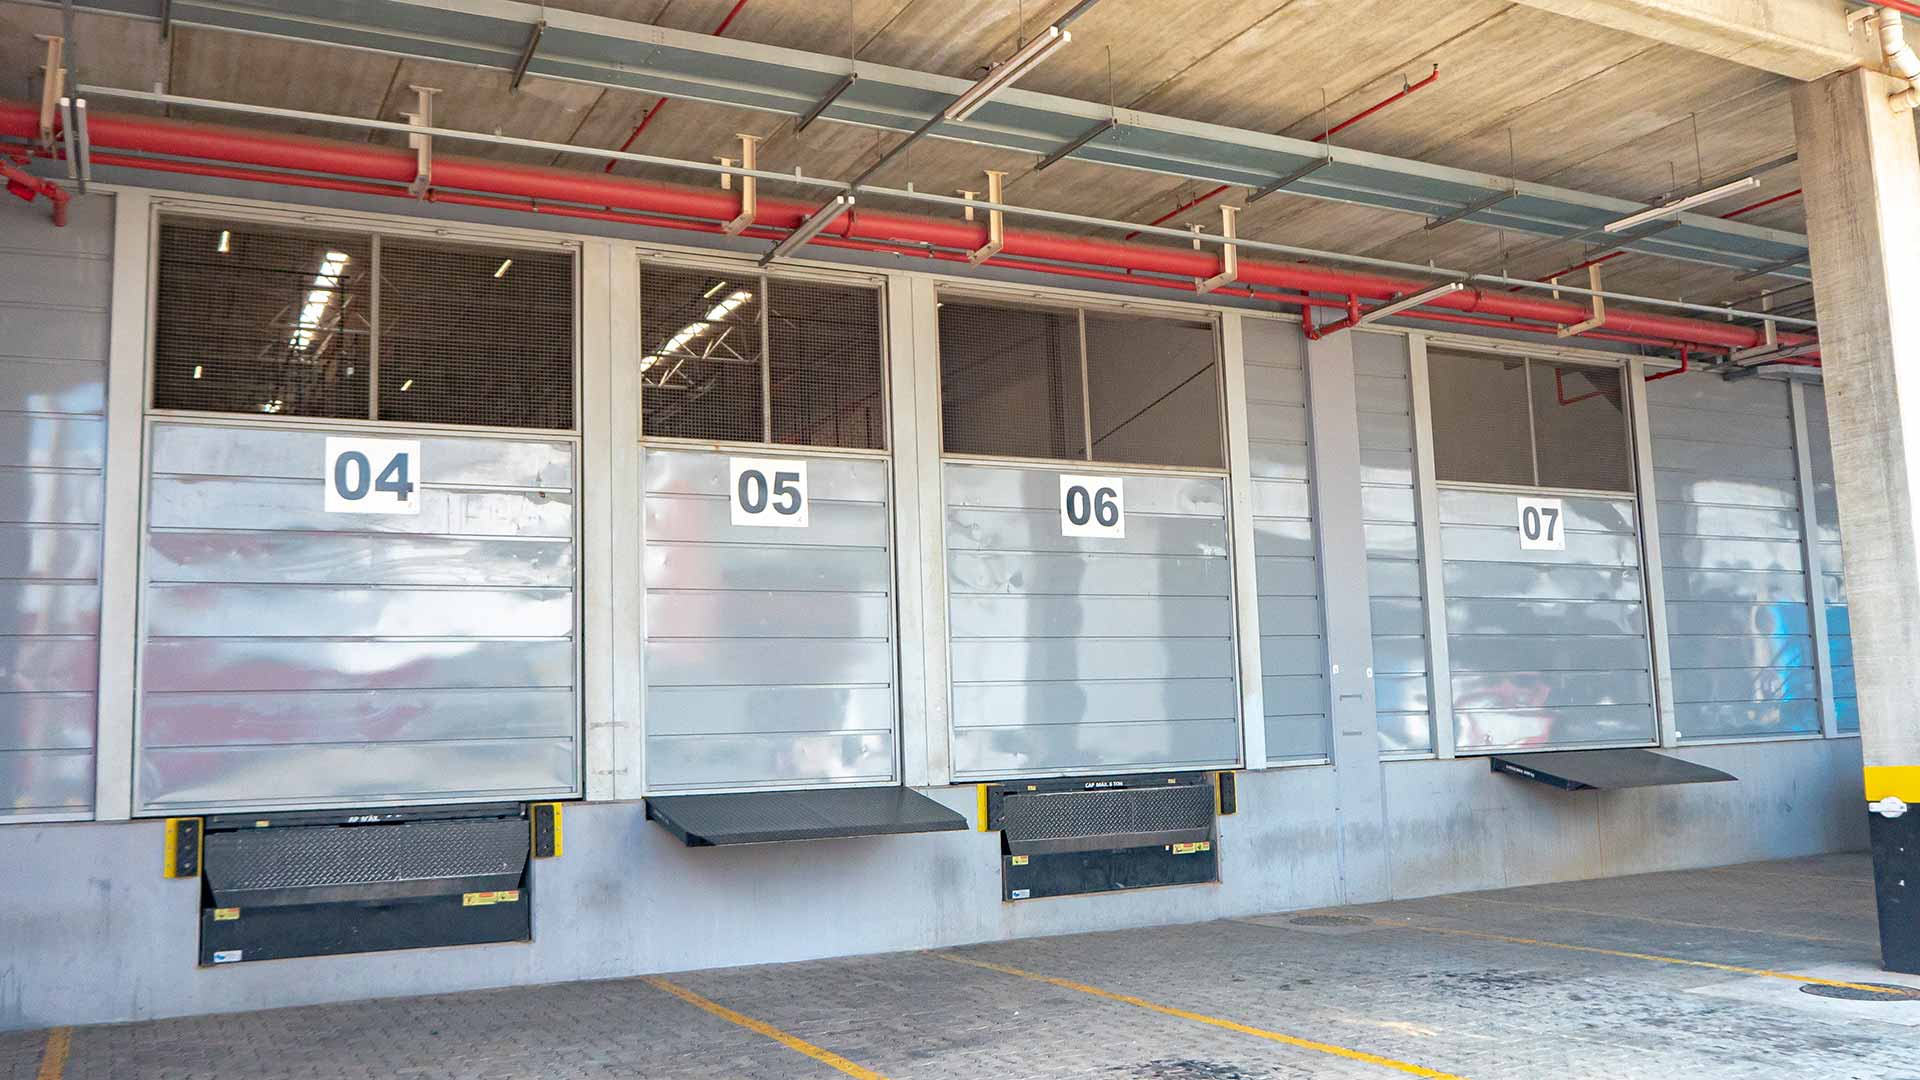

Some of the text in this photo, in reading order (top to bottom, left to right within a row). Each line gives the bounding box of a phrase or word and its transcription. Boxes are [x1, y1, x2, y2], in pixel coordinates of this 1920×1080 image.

[334, 450, 414, 502] 04
[737, 469, 803, 516] 05
[1066, 484, 1119, 528] 06
[1522, 506, 1559, 542] 07
